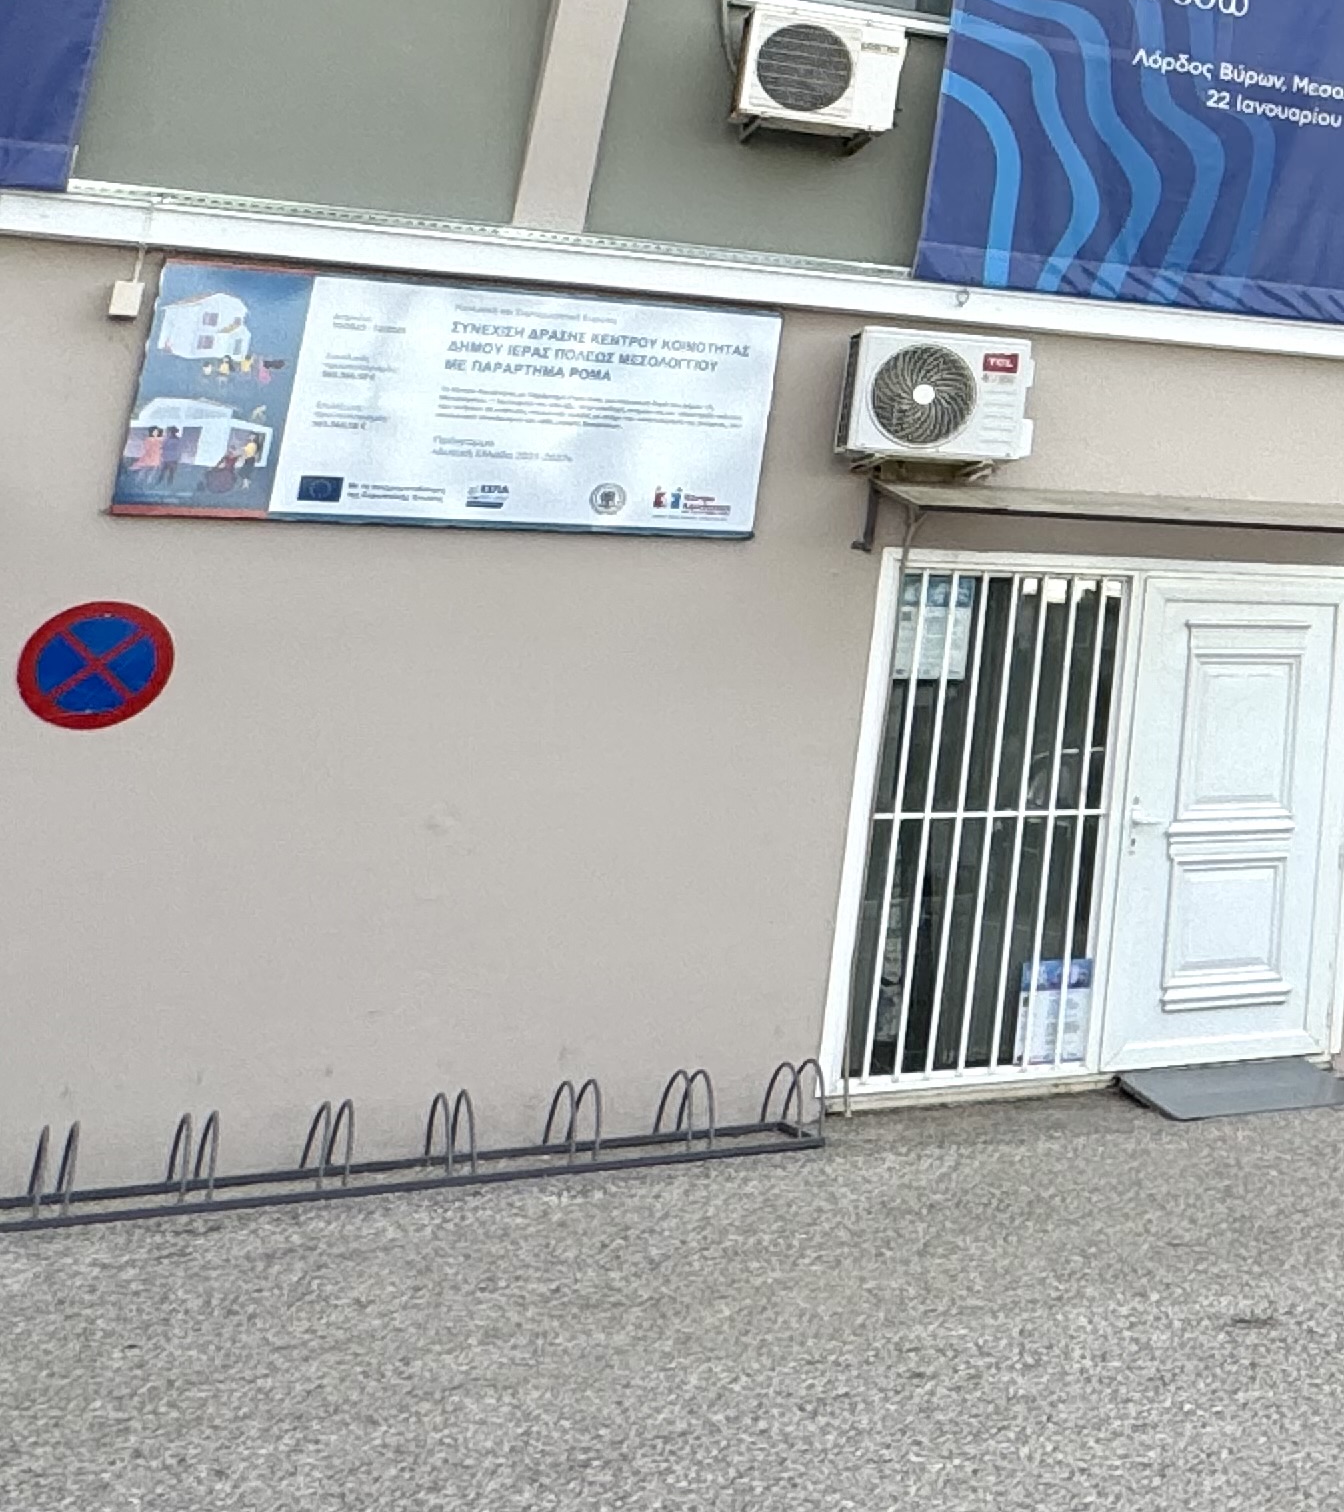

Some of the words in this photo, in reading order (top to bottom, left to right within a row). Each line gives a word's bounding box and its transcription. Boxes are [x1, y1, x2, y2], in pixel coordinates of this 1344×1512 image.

[1132, 48, 1214, 80] Λόρδος
[1219, 62, 1288, 93] Βύρων,
[1206, 89, 1230, 110] 22
[1236, 94, 1342, 127] Ιανουαρίου
[507, 344, 552, 360] ΙΕΡΑΣ
